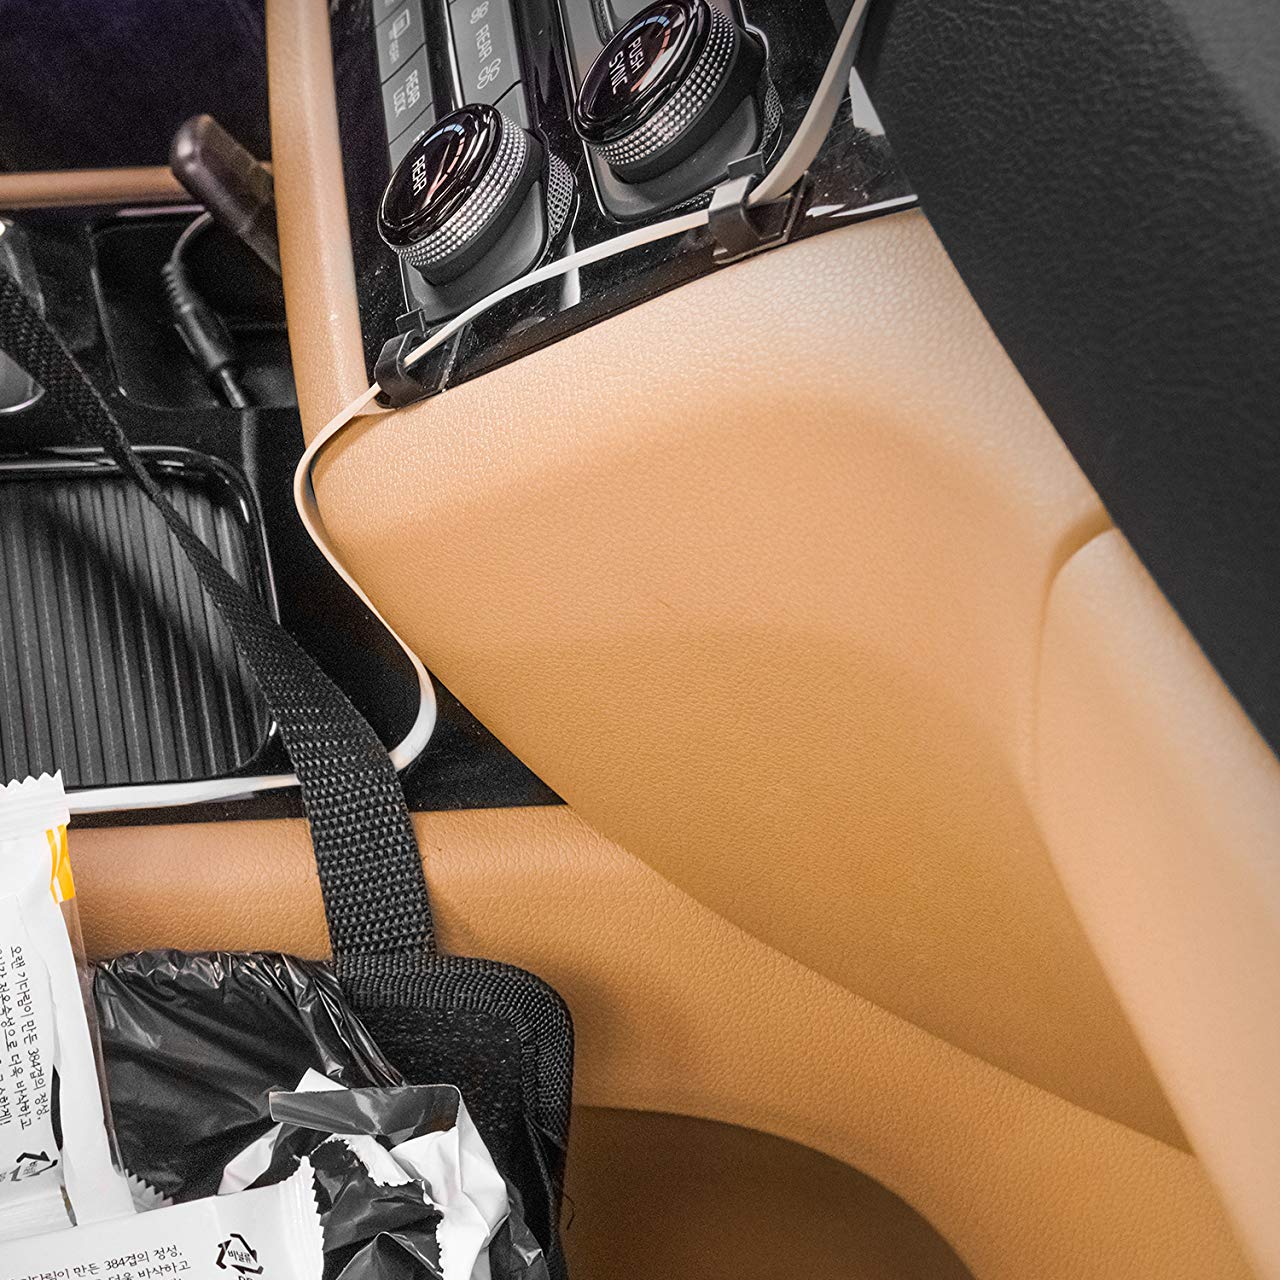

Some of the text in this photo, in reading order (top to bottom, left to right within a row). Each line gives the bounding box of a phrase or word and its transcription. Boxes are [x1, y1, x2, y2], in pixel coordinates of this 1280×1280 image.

[476, 24, 493, 63] REAR
[628, 36, 645, 74] PUSH
[406, 69, 420, 109] REAR
[609, 51, 628, 95] SYNC
[393, 86, 407, 118] LOCK
[412, 153, 427, 196] REAR
[11, 946, 26, 969] 오랜
[15, 972, 34, 1018] 기다림이
[21, 1020, 38, 1045] 만든
[8, 1053, 24, 1078] 더욱
[28, 1048, 46, 1090] 384겹의
[14, 1080, 32, 1130] 바삭하고
[73, 1262, 100, 1278] 만든
[104, 1251, 150, 1271] 384겹의
[137, 1260, 191, 1279] 바삭하고
[227, 1249, 252, 1265] 비닐류
